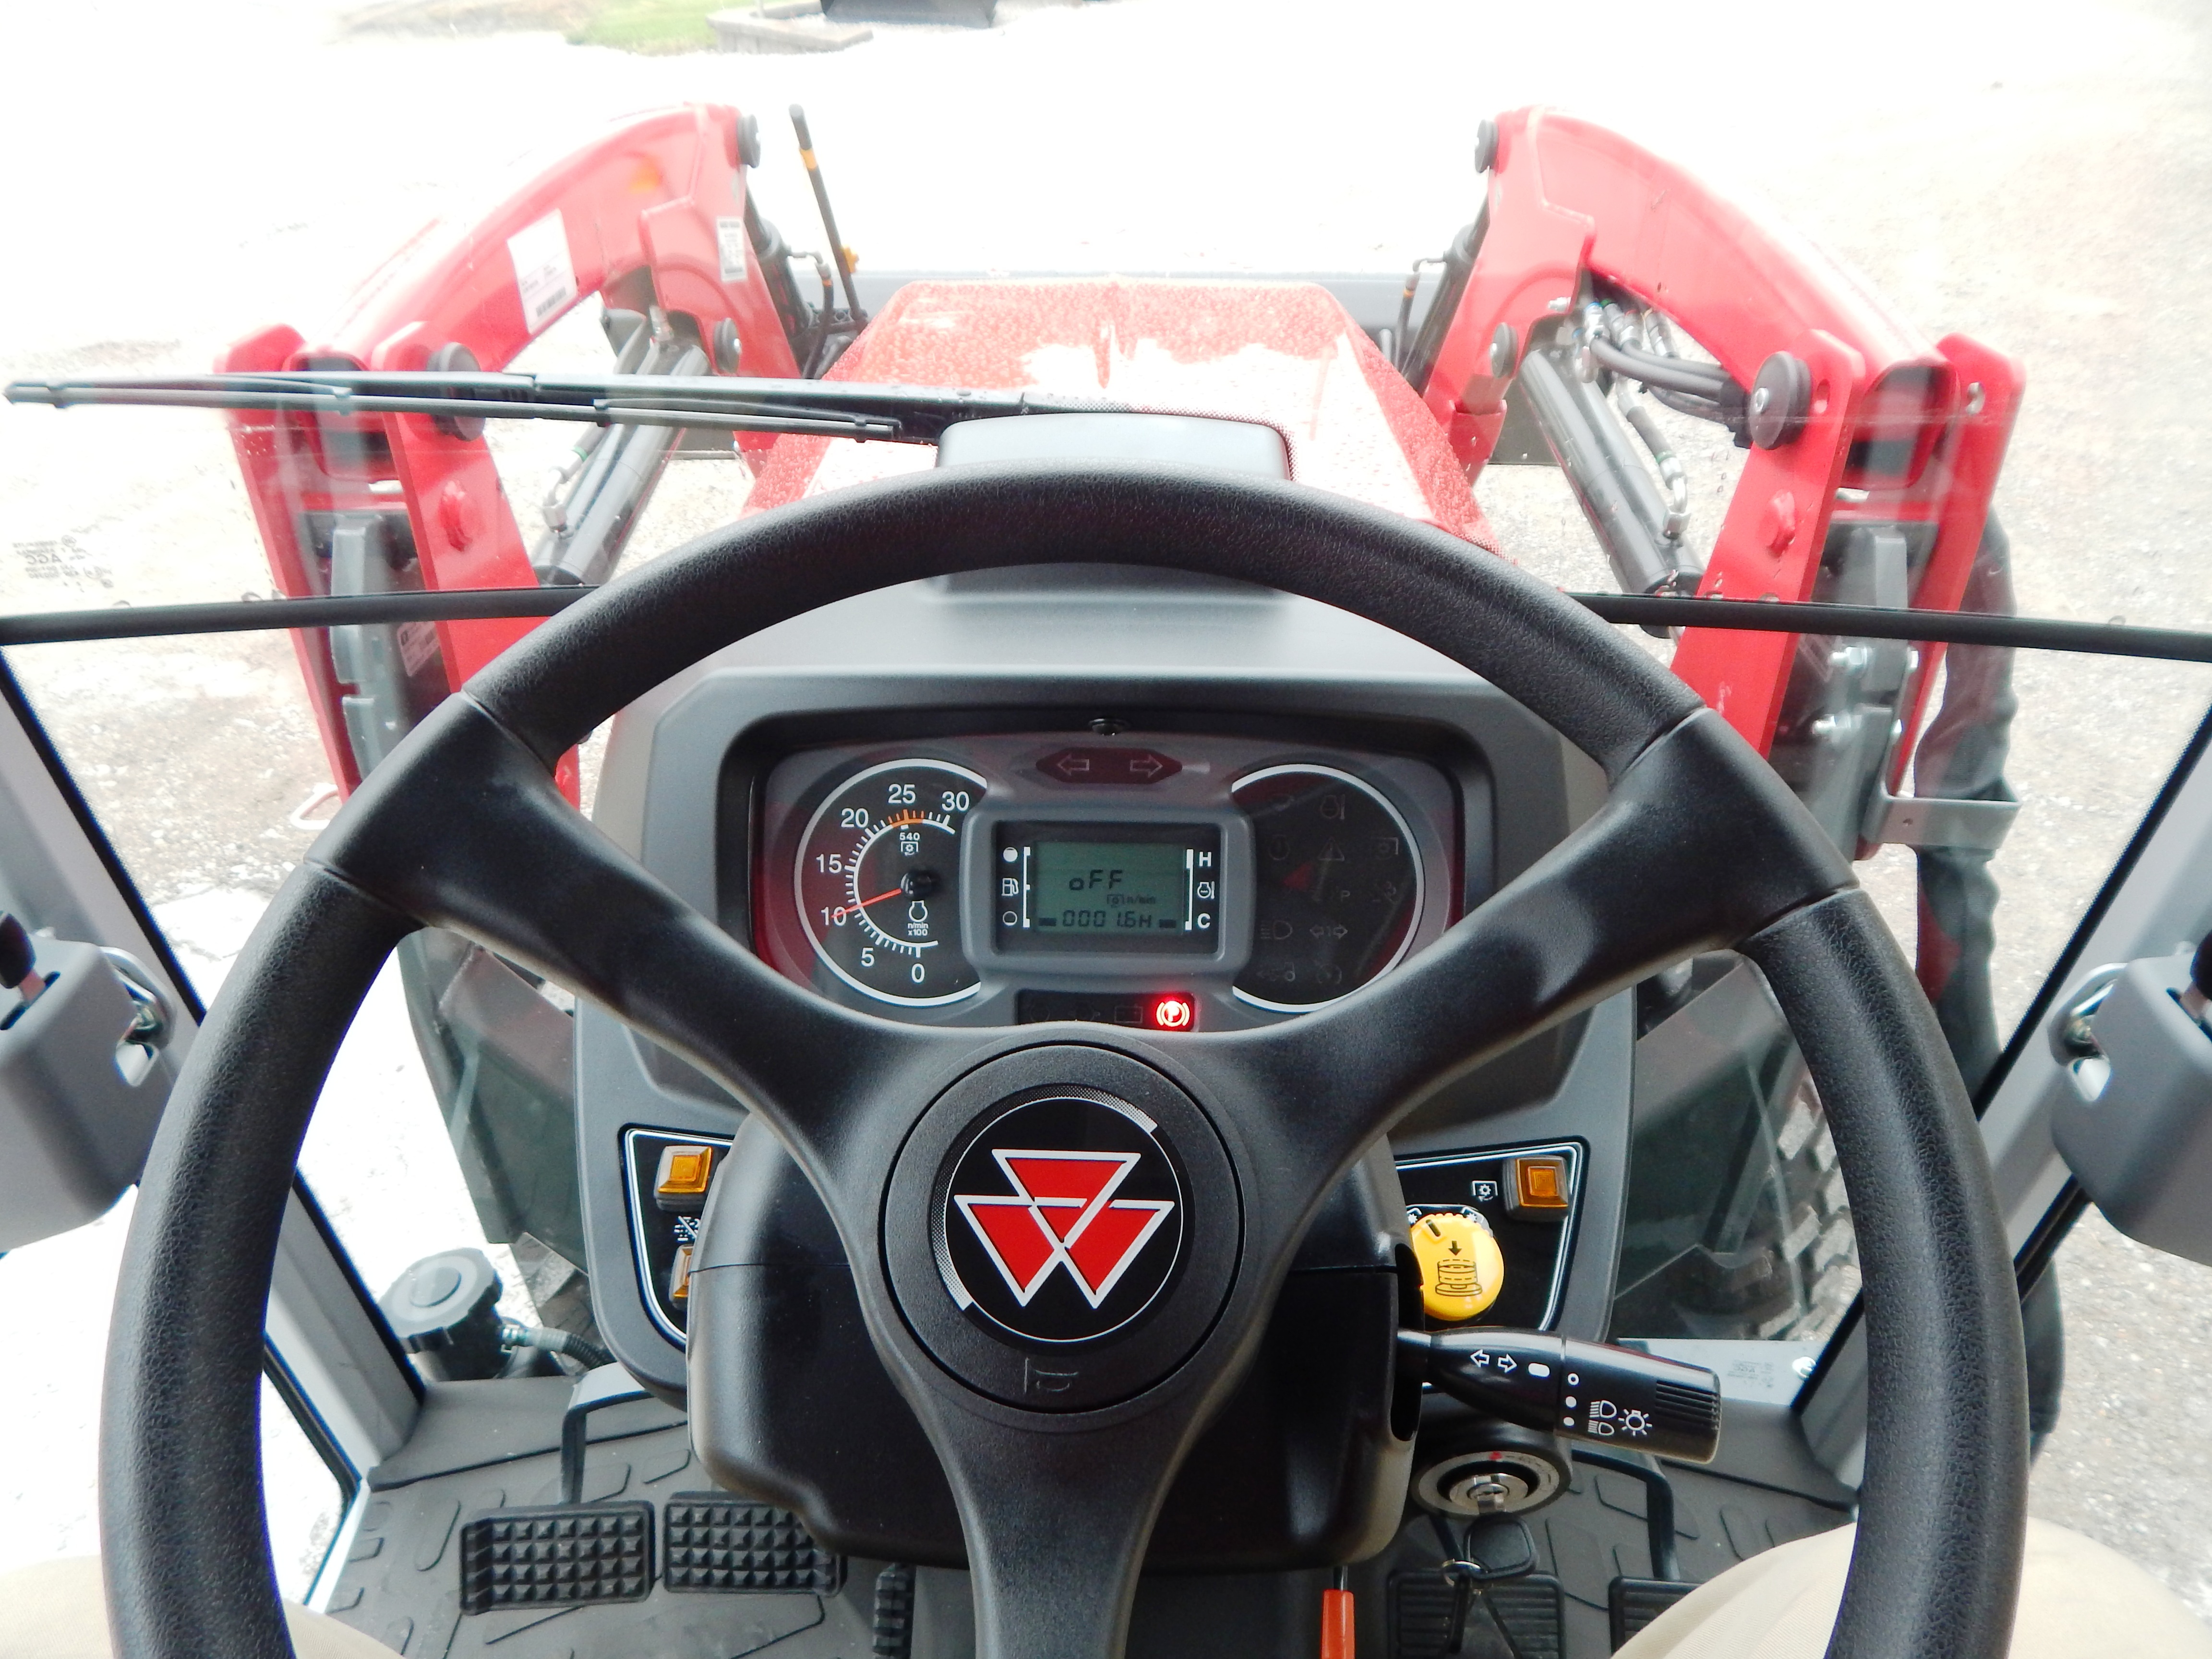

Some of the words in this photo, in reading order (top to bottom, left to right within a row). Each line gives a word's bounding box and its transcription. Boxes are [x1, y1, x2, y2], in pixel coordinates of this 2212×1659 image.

[888, 784, 916, 804] 25
[941, 792, 970, 811] 30
[841, 808, 869, 828] 20
[816, 854, 842, 873] 15
[1200, 852, 1212, 866] H
[821, 906, 847, 926] 10
[1197, 913, 1210, 929] C
[861, 947, 875, 967] 5
[911, 963, 925, 983] 0
